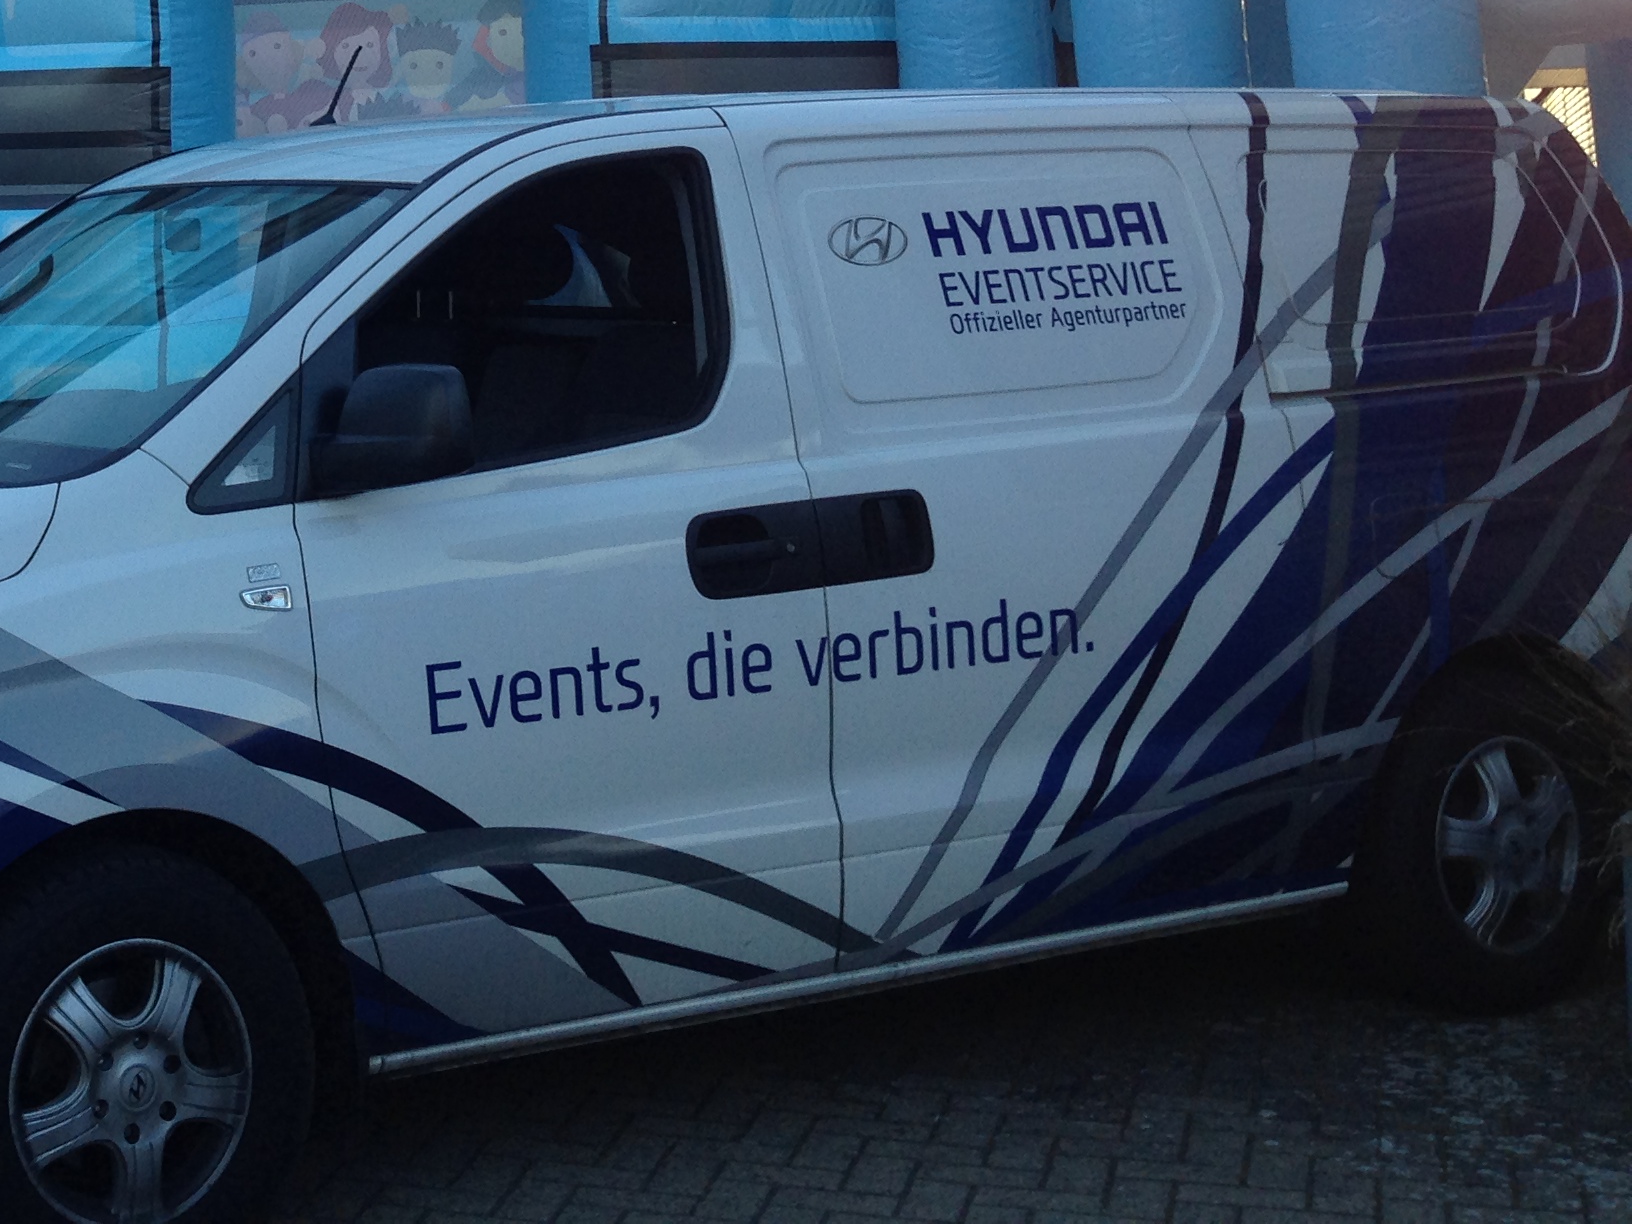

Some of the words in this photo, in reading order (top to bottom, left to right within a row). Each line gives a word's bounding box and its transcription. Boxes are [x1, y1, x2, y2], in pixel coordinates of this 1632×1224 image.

[921, 201, 1169, 257] HYUNDAI
[938, 259, 1183, 307] EVENTSERVICE
[949, 310, 1043, 335] Offizieller
[1051, 300, 1187, 332] Agenturpartner
[425, 646, 661, 735] Events,
[686, 629, 774, 701] die
[795, 598, 1095, 688] verbinden.
